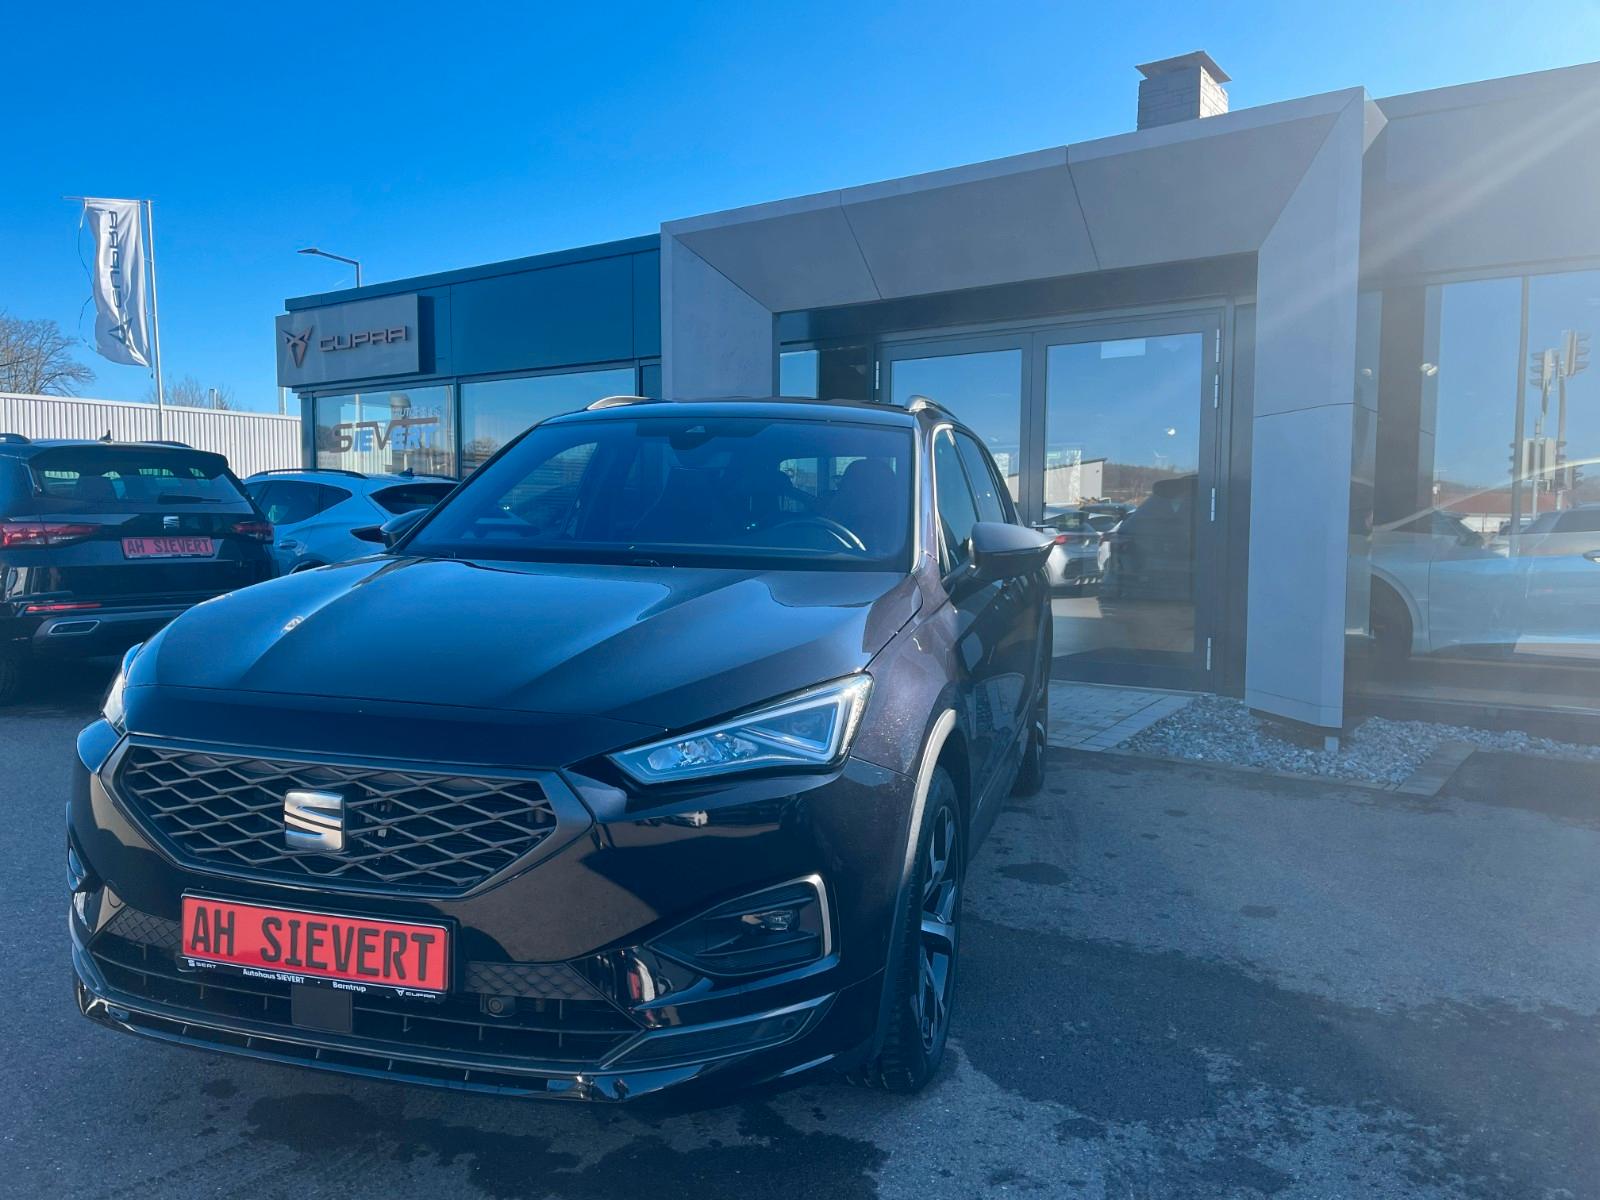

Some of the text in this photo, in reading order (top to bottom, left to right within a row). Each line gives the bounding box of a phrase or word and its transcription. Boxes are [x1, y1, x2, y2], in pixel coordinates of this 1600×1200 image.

[319, 325, 408, 352] CUPRA
[328, 416, 438, 454] SIEVERT
[127, 538, 210, 554] AH SIEVERT
[191, 906, 436, 982] AH SIEVERT
[242, 968, 305, 984] Autohaus SIEVERT
[332, 981, 367, 993] Barntrup
